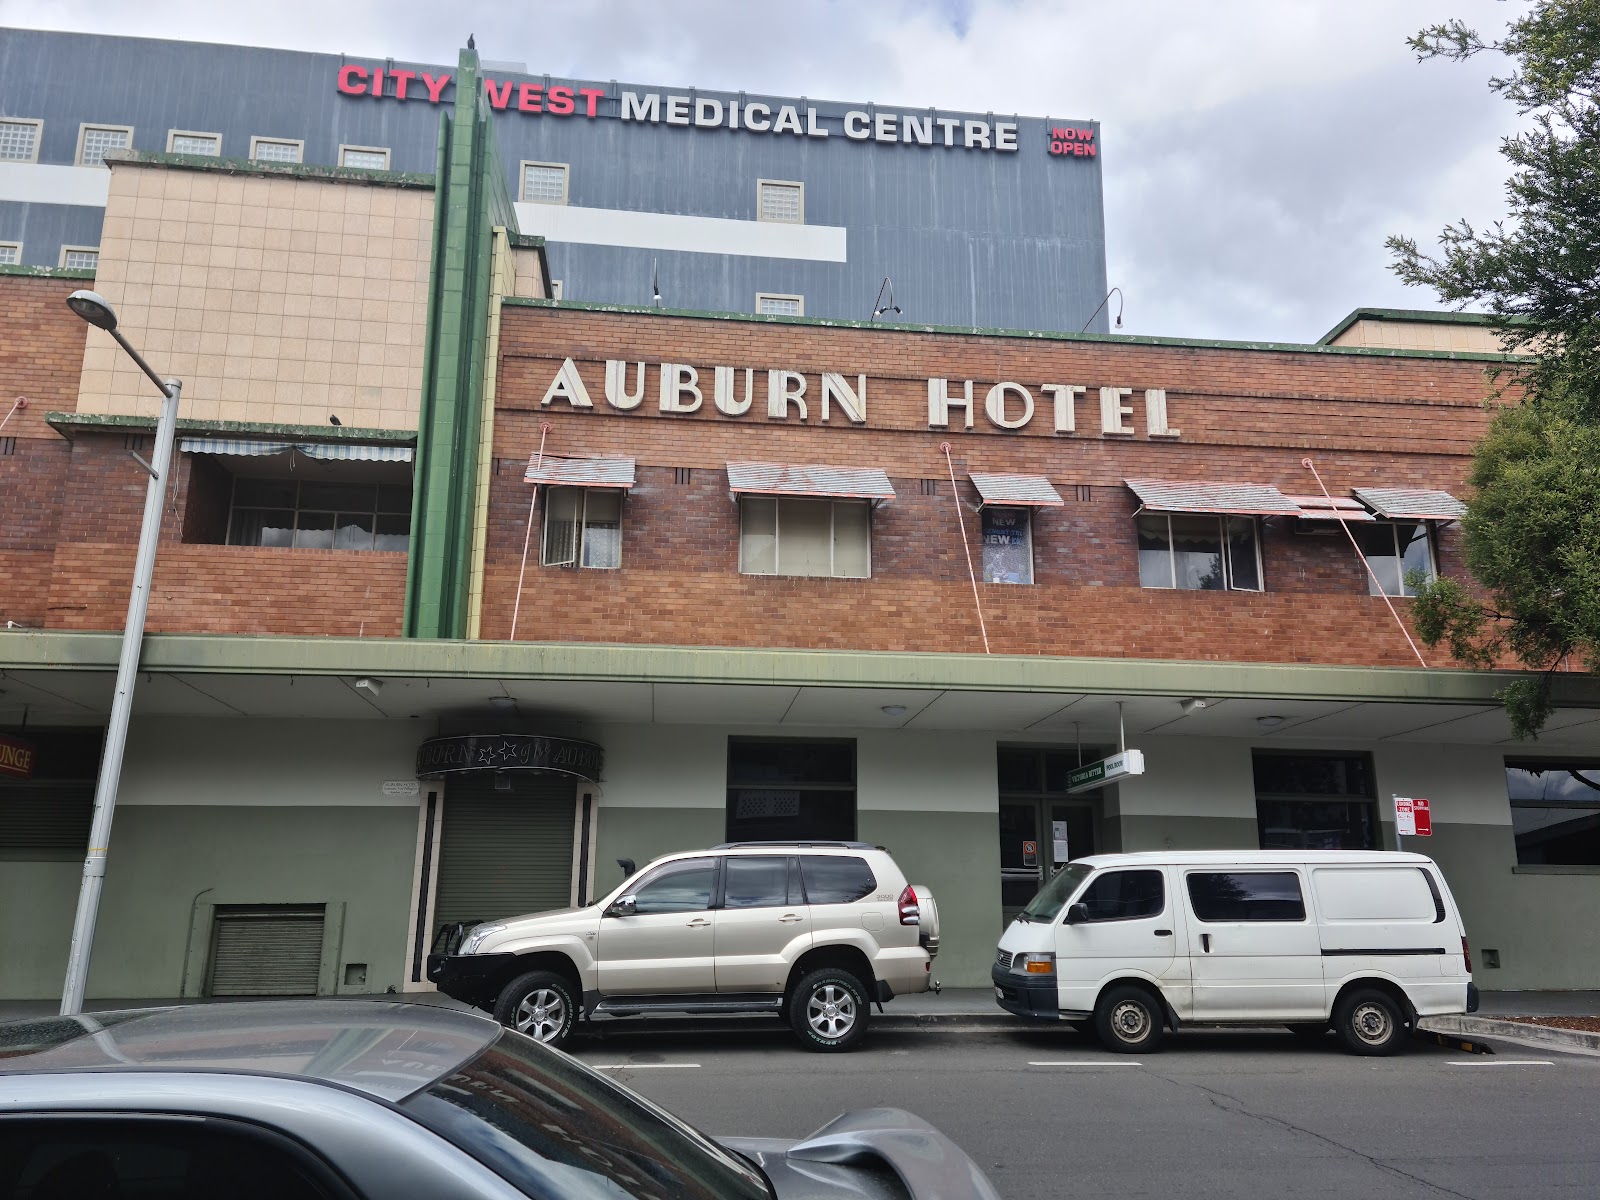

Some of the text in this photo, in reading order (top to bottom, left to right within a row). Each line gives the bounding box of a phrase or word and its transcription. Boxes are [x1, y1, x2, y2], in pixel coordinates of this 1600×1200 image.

[337, 65, 452, 104] CITY
[621, 91, 829, 137] MEDICAL
[844, 110, 1018, 151] CENTRE
[1052, 127, 1094, 141] NOW
[1050, 141, 1096, 156] OPEN
[541, 357, 1181, 438] AUBURN HOTEL
[992, 518, 1016, 526] NEW
[1072, 767, 1102, 782] VICTORIA BITTER
